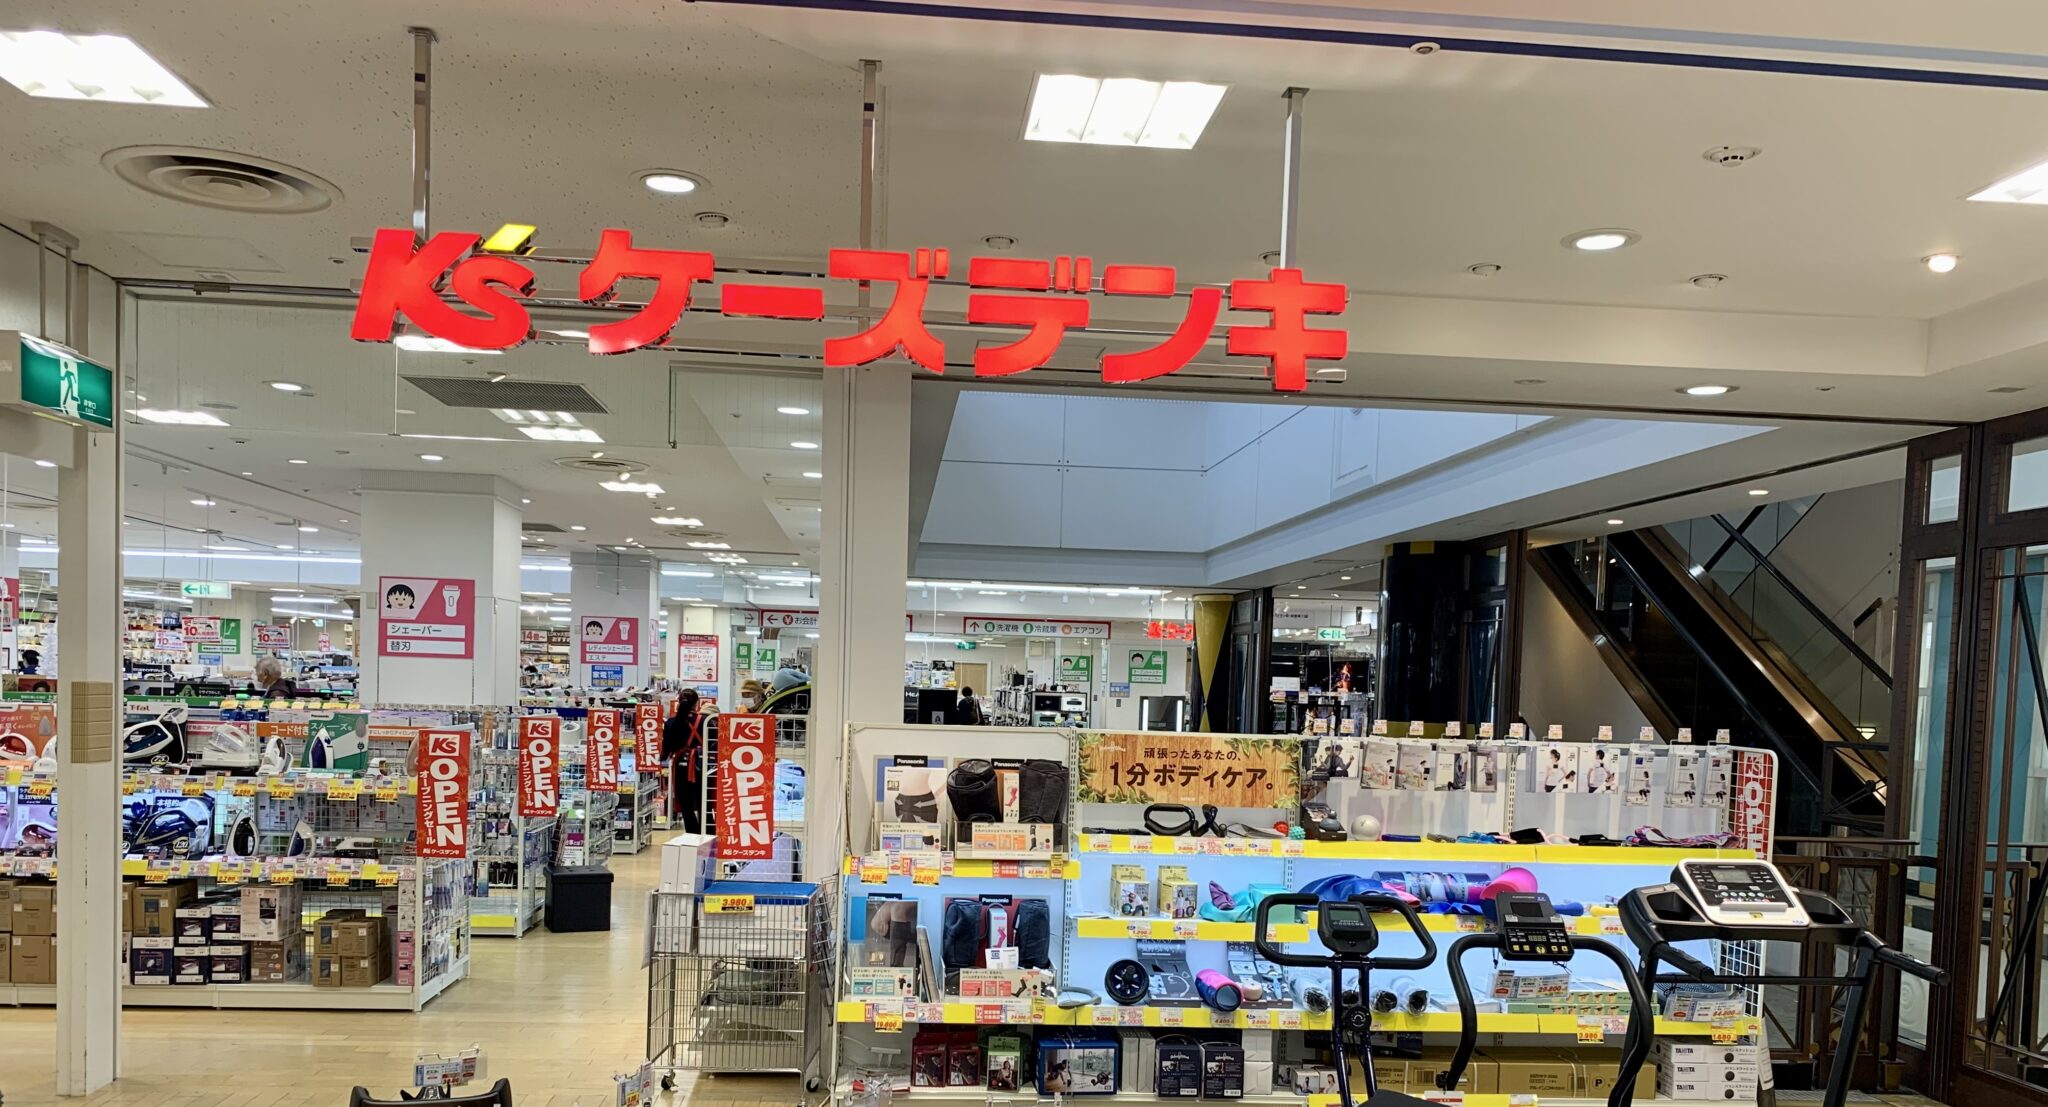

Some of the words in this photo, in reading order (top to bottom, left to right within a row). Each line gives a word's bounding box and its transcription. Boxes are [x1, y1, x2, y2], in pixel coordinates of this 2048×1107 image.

[351, 224, 538, 350] K's
[579, 229, 1348, 392] ケーズデンキ
[390, 624, 443, 635] シェーバー
[390, 640, 412, 652] 替刃
[996, 624, 1019, 633] 洗濯機
[1033, 625, 1057, 634] 冷蔵庫
[1073, 627, 1103, 635] エアコン
[271, 725, 309, 736] コード付き
[594, 727, 616, 784] OPEN
[642, 719, 660, 766] OPEN
[1143, 747, 1242, 761] 頑張ったあなたの、
[521, 749, 534, 807] オープニングセール
[528, 739, 556, 808] OPEN
[719, 759, 739, 845] オープニングセール
[730, 745, 771, 848] OPEN
[1110, 761, 1274, 790] 1分ボディケア。
[419, 770, 436, 846] オープニングセール
[430, 758, 464, 847] OPEN
[1744, 781, 1765, 860] OPE
